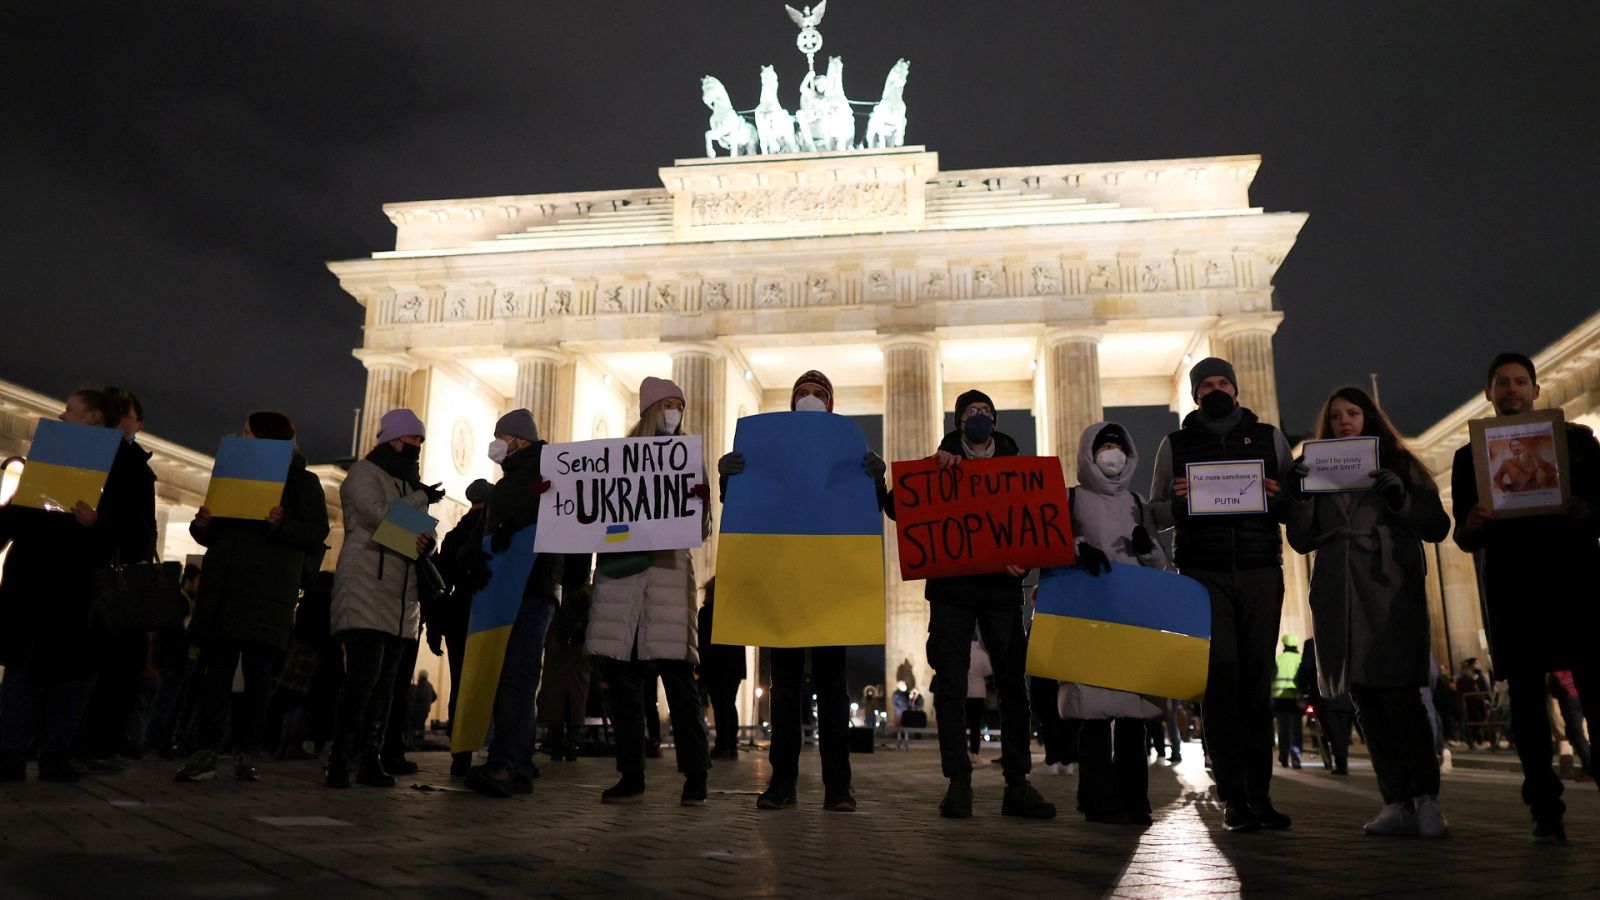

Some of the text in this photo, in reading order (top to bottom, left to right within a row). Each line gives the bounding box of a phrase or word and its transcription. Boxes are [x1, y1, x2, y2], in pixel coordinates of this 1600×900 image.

[556, 438, 688, 475] Send NATO
[1339, 463, 1362, 471] SWIFT
[553, 473, 696, 524] to UKRAINE
[898, 465, 1044, 508] STOP PUTIN
[1214, 497, 1240, 505] PUTIN
[902, 503, 1068, 569] STOP WAR
